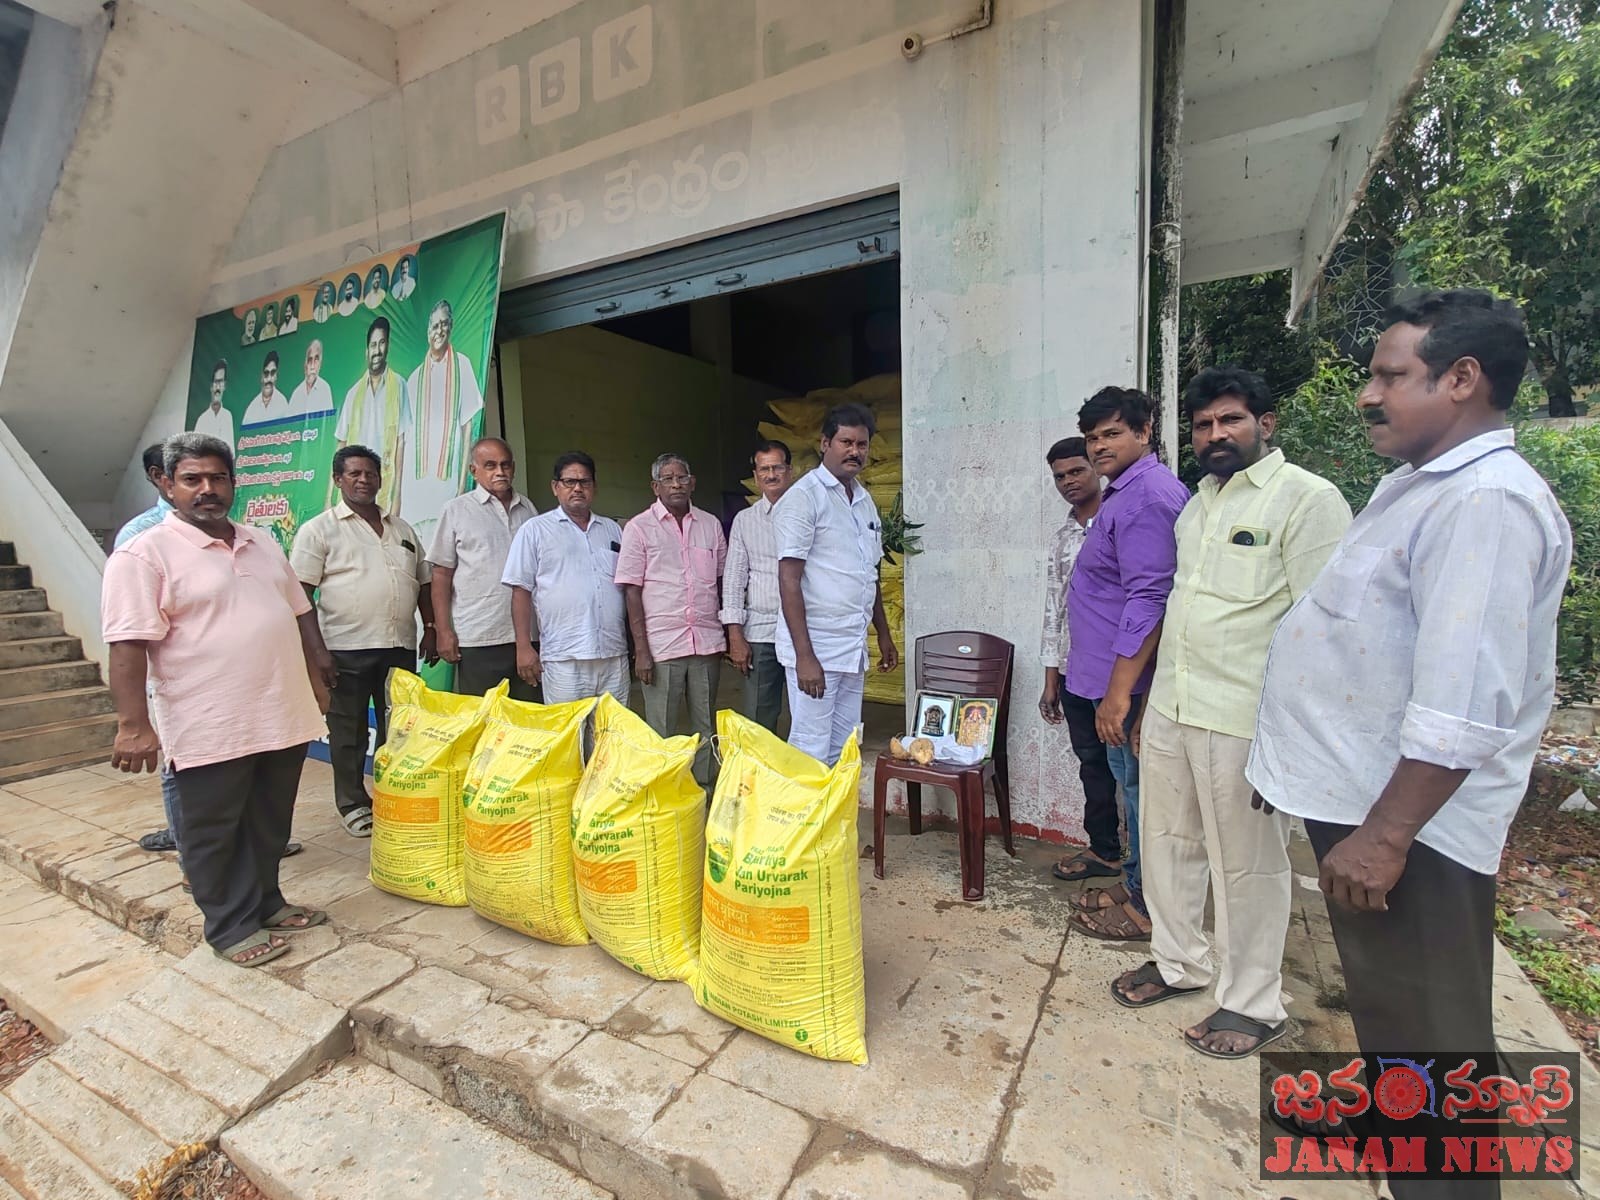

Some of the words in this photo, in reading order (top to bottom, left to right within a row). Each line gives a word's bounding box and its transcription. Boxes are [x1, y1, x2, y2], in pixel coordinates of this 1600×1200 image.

[756, 868, 809, 883] Urvarak
[734, 879, 792, 899] Pariyojna
[732, 1006, 763, 1024] POTASH
[765, 1018, 801, 1028] LIMITED
